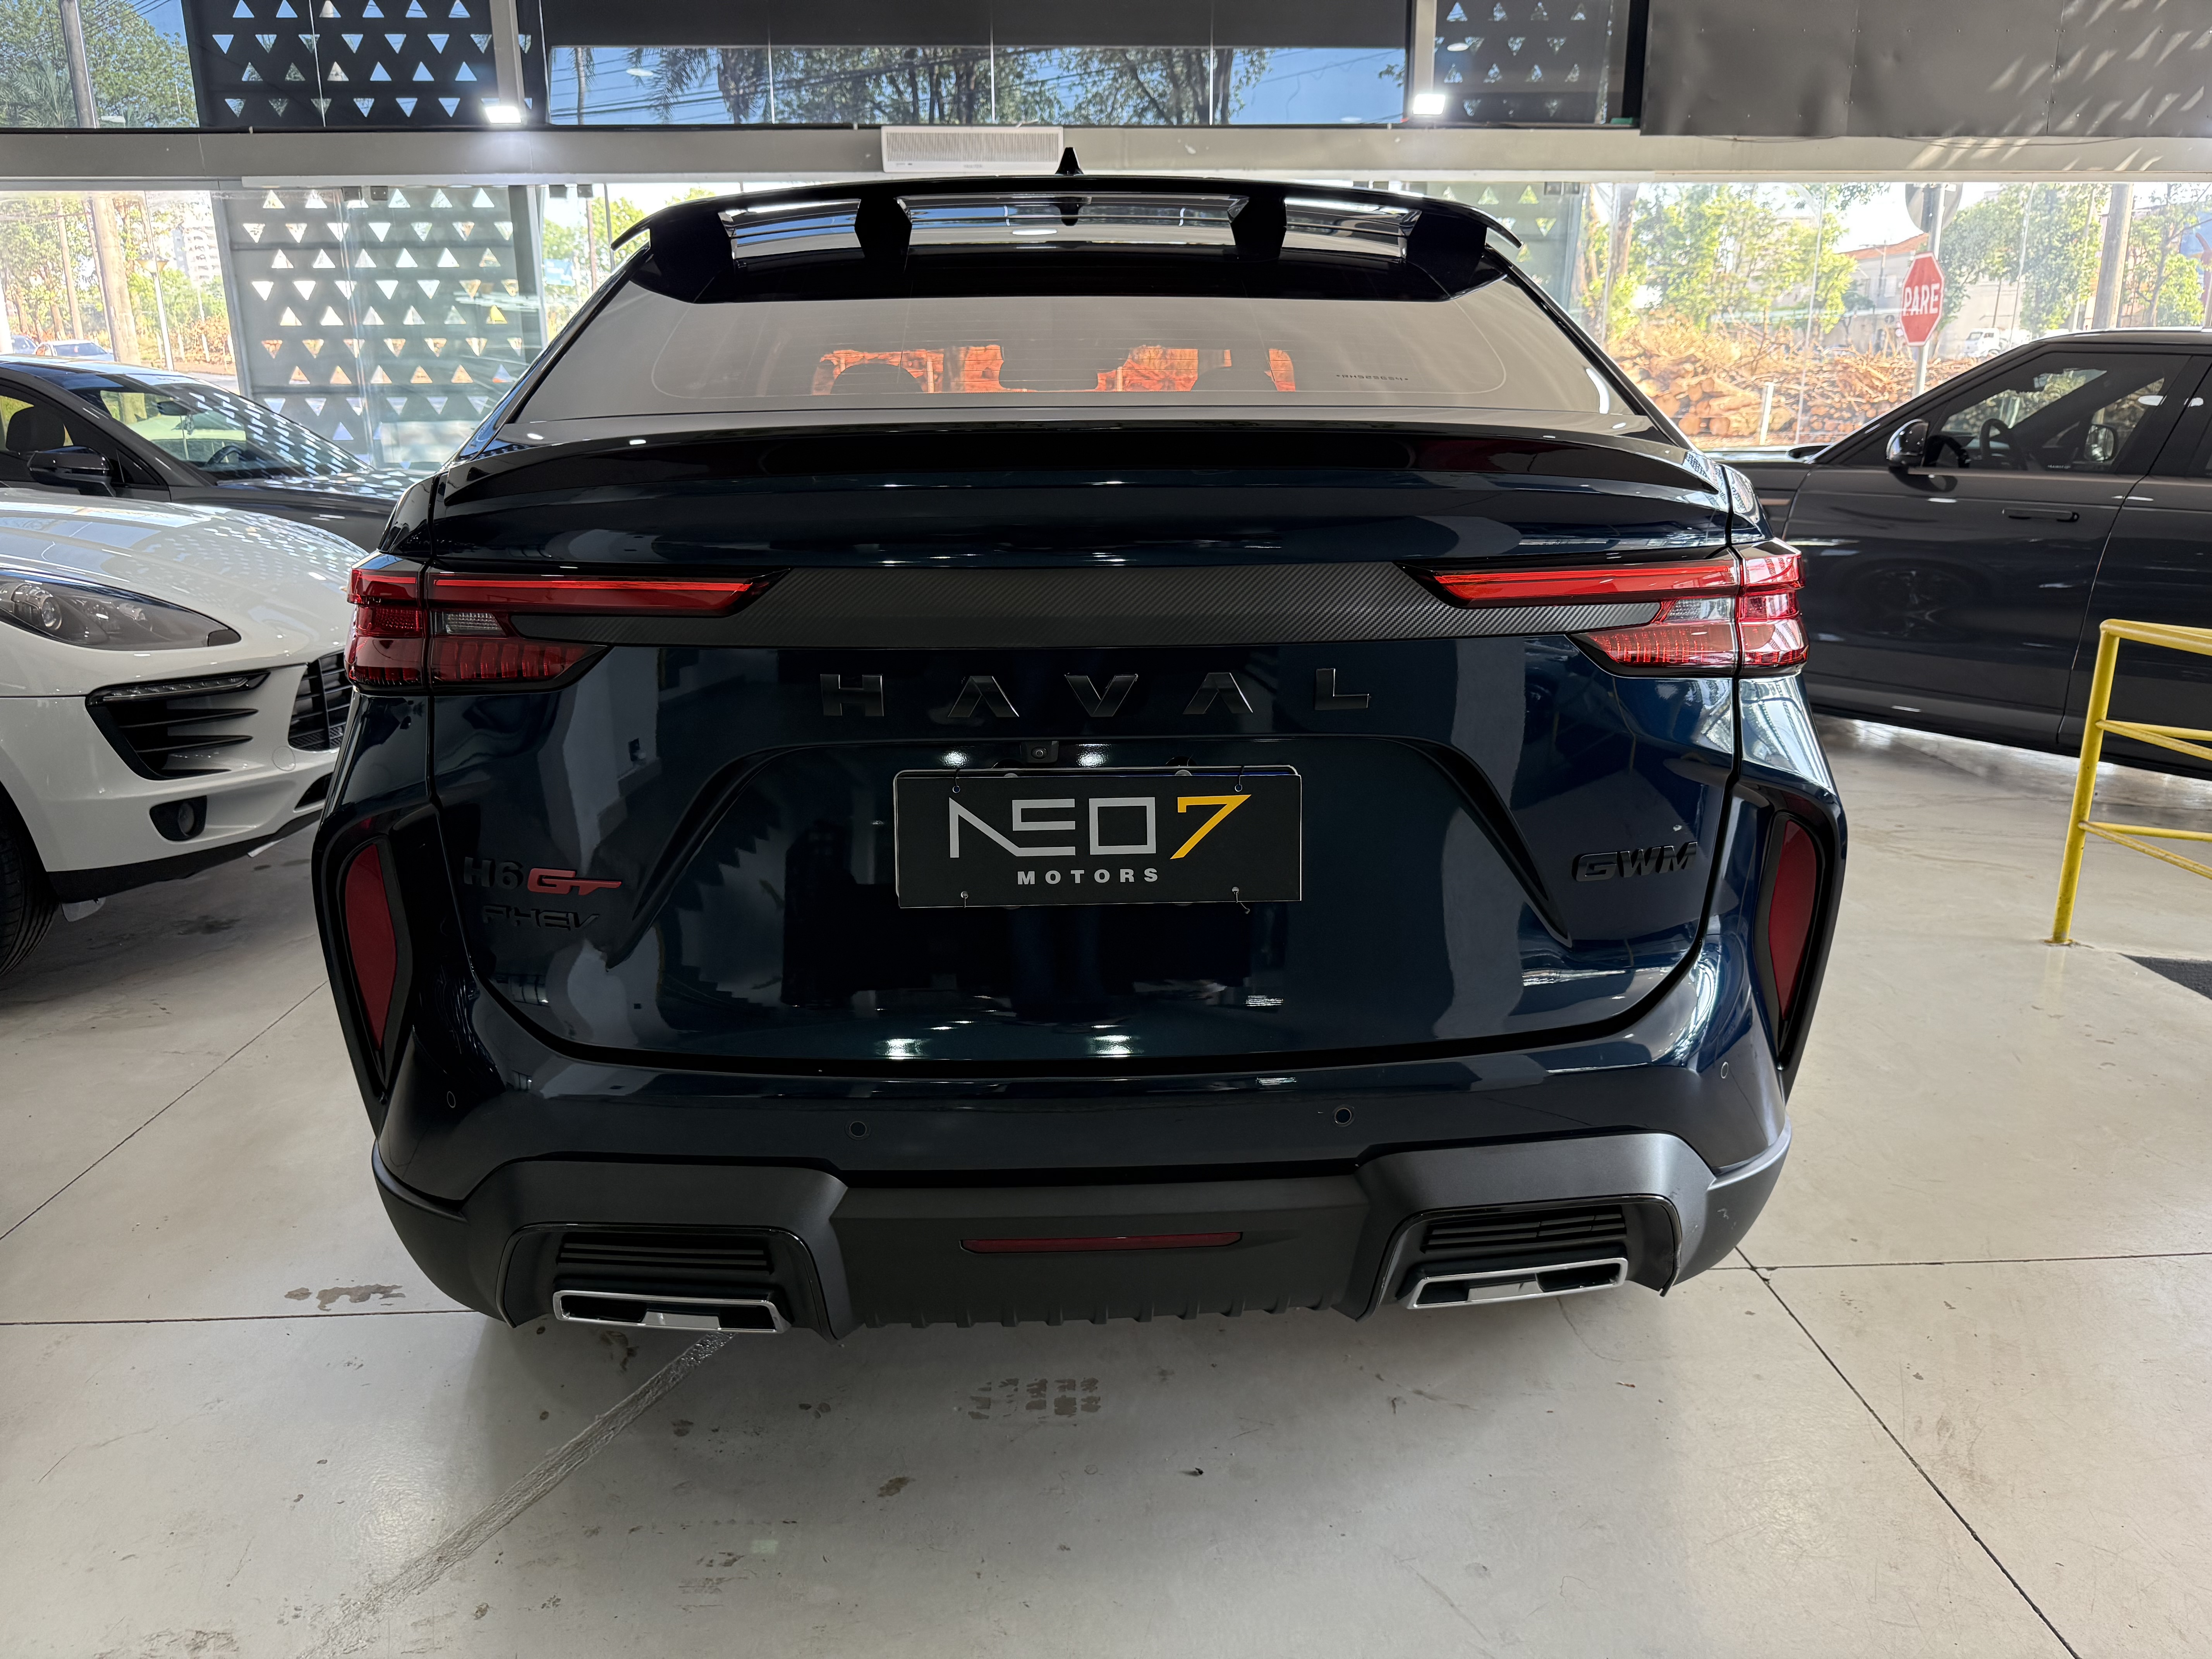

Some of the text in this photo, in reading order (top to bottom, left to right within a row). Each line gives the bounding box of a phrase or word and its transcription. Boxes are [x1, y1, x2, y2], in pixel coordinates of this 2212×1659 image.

[1903, 284, 1939, 316] PARE
[820, 668, 1370, 716] HAVAL
[464, 856, 523, 890] H6
[1017, 868, 1158, 885] MOTORS
[1572, 842, 1698, 881] GWM
[483, 905, 599, 931] PHEV
